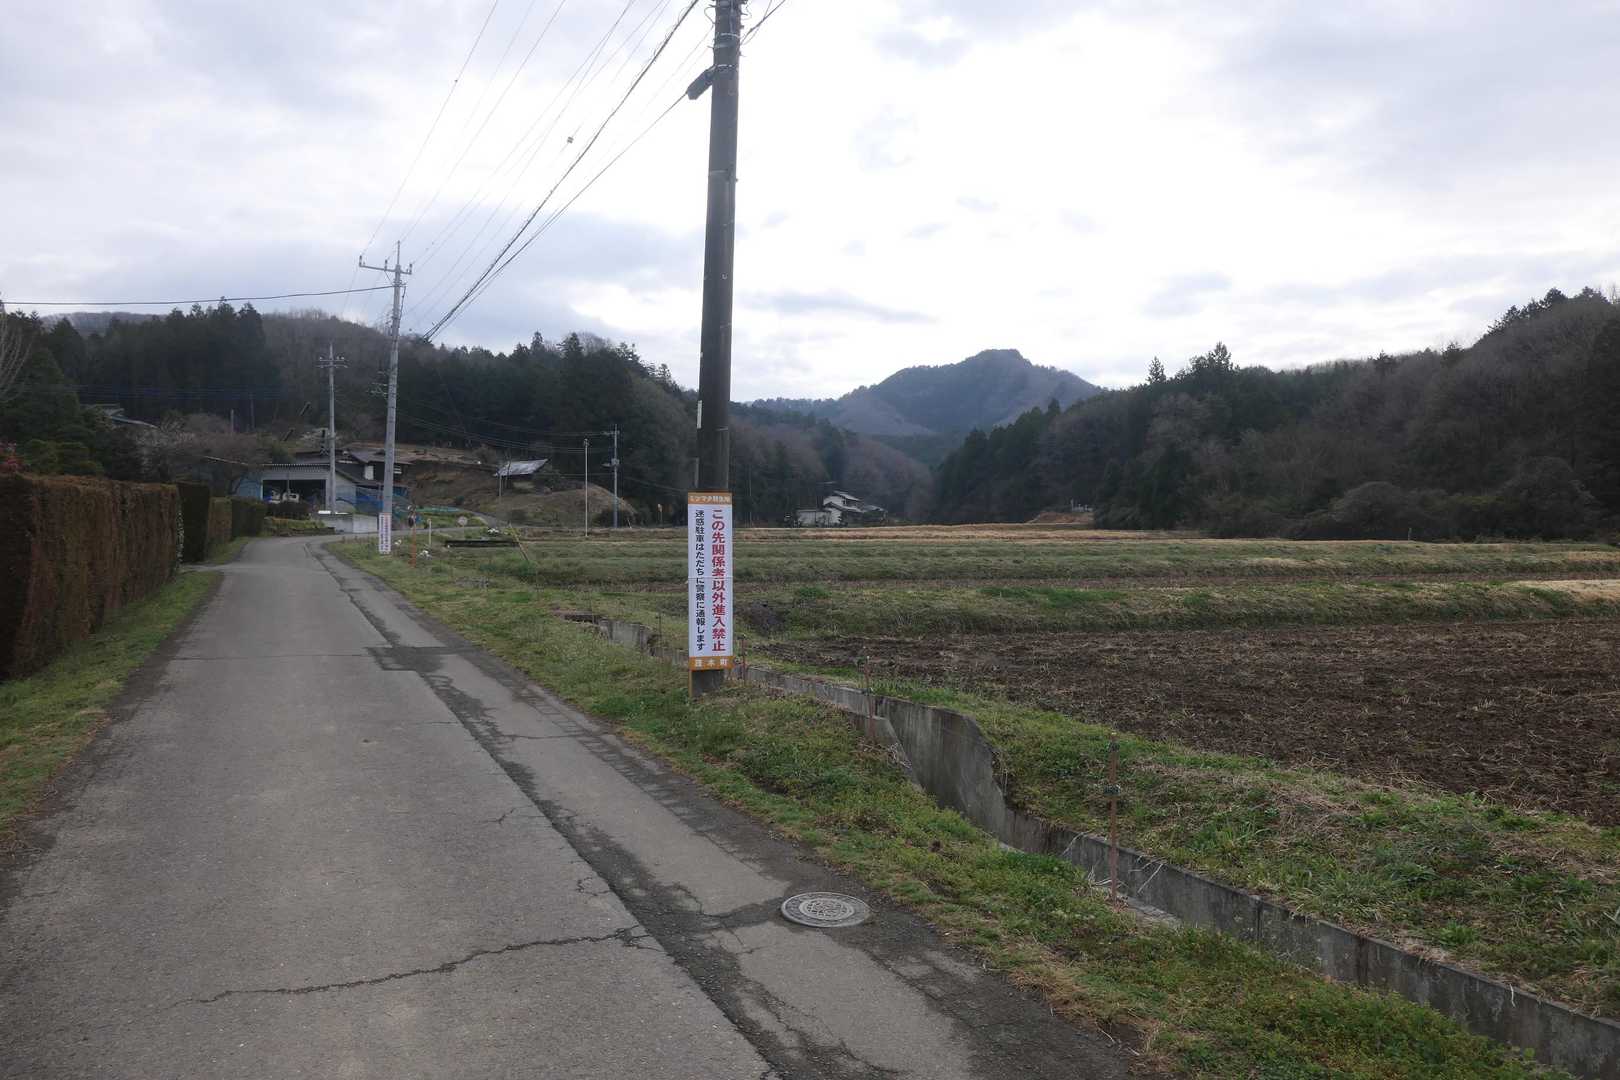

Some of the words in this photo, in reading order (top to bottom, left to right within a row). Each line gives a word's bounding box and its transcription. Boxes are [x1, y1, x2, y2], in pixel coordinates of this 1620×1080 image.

[695, 509, 706, 652] 迷惑駐車はただちに警察に通報します
[711, 509, 726, 652] この先関係者以外進入禁止
